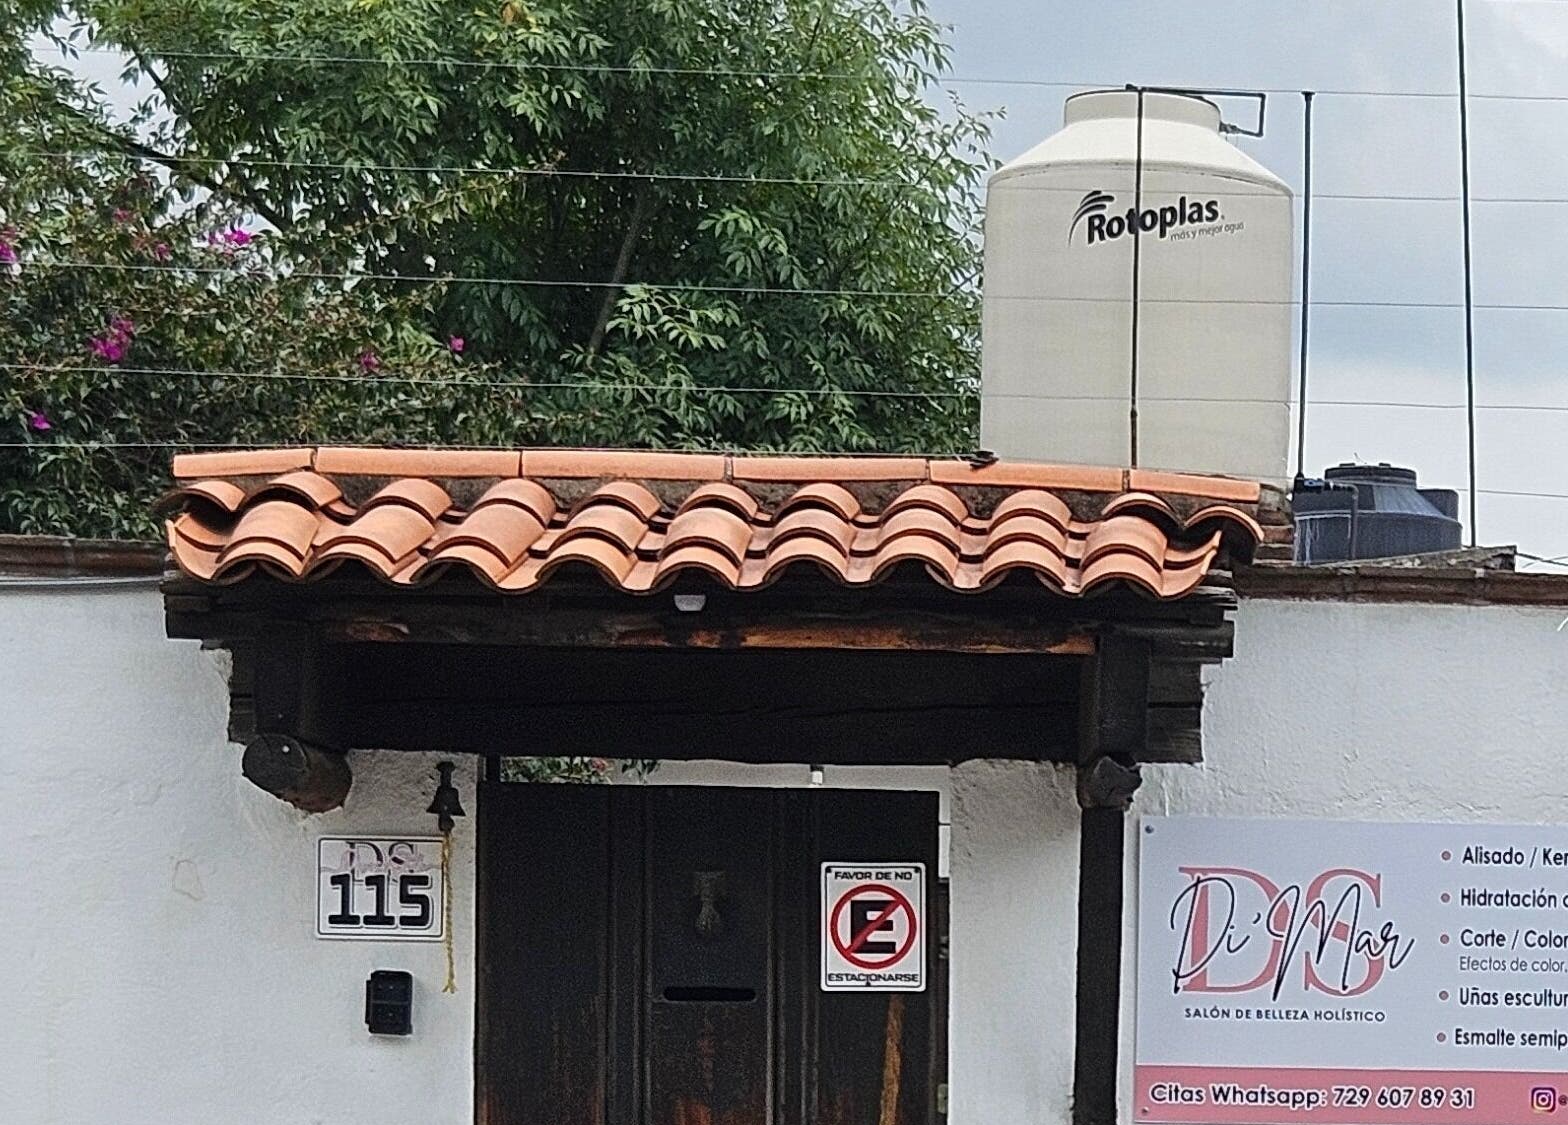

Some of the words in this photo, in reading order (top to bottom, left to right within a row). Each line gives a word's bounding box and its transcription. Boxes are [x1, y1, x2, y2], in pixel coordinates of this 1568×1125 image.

[1087, 195, 1219, 244] Rotoplas
[1224, 222, 1244, 234] agua
[1461, 846, 1525, 865] Alisado
[1529, 846, 1538, 868] /
[834, 871, 872, 880] FAVOR
[875, 871, 892, 880] DE
[895, 871, 913, 880] NO
[327, 873, 432, 928] 115
[1460, 887, 1557, 908] Hidratación
[1460, 928, 1506, 947] Corte
[1511, 929, 1520, 950] /
[1459, 956, 1507, 972] Efectos
[1509, 956, 1528, 972] de
[1531, 957, 1568, 973] color.
[828, 973, 919, 982] ESTACIONARSE
[1459, 987, 1499, 1006] Uñas
[1184, 1005, 1231, 1019] SALÓN
[1235, 1008, 1252, 1020] DE
[1256, 1009, 1310, 1021] BELLEZA
[1314, 1007, 1386, 1022] HOLÍSTICO
[1455, 1028, 1516, 1046] Esmalte
[1150, 1083, 1205, 1103] Citas
[1211, 1084, 1327, 1109] Whatsapp:
[1333, 1088, 1370, 1106] 729
[1377, 1088, 1413, 1107] 607
[1420, 1089, 1443, 1108] 89
[1450, 1089, 1474, 1108] 31
